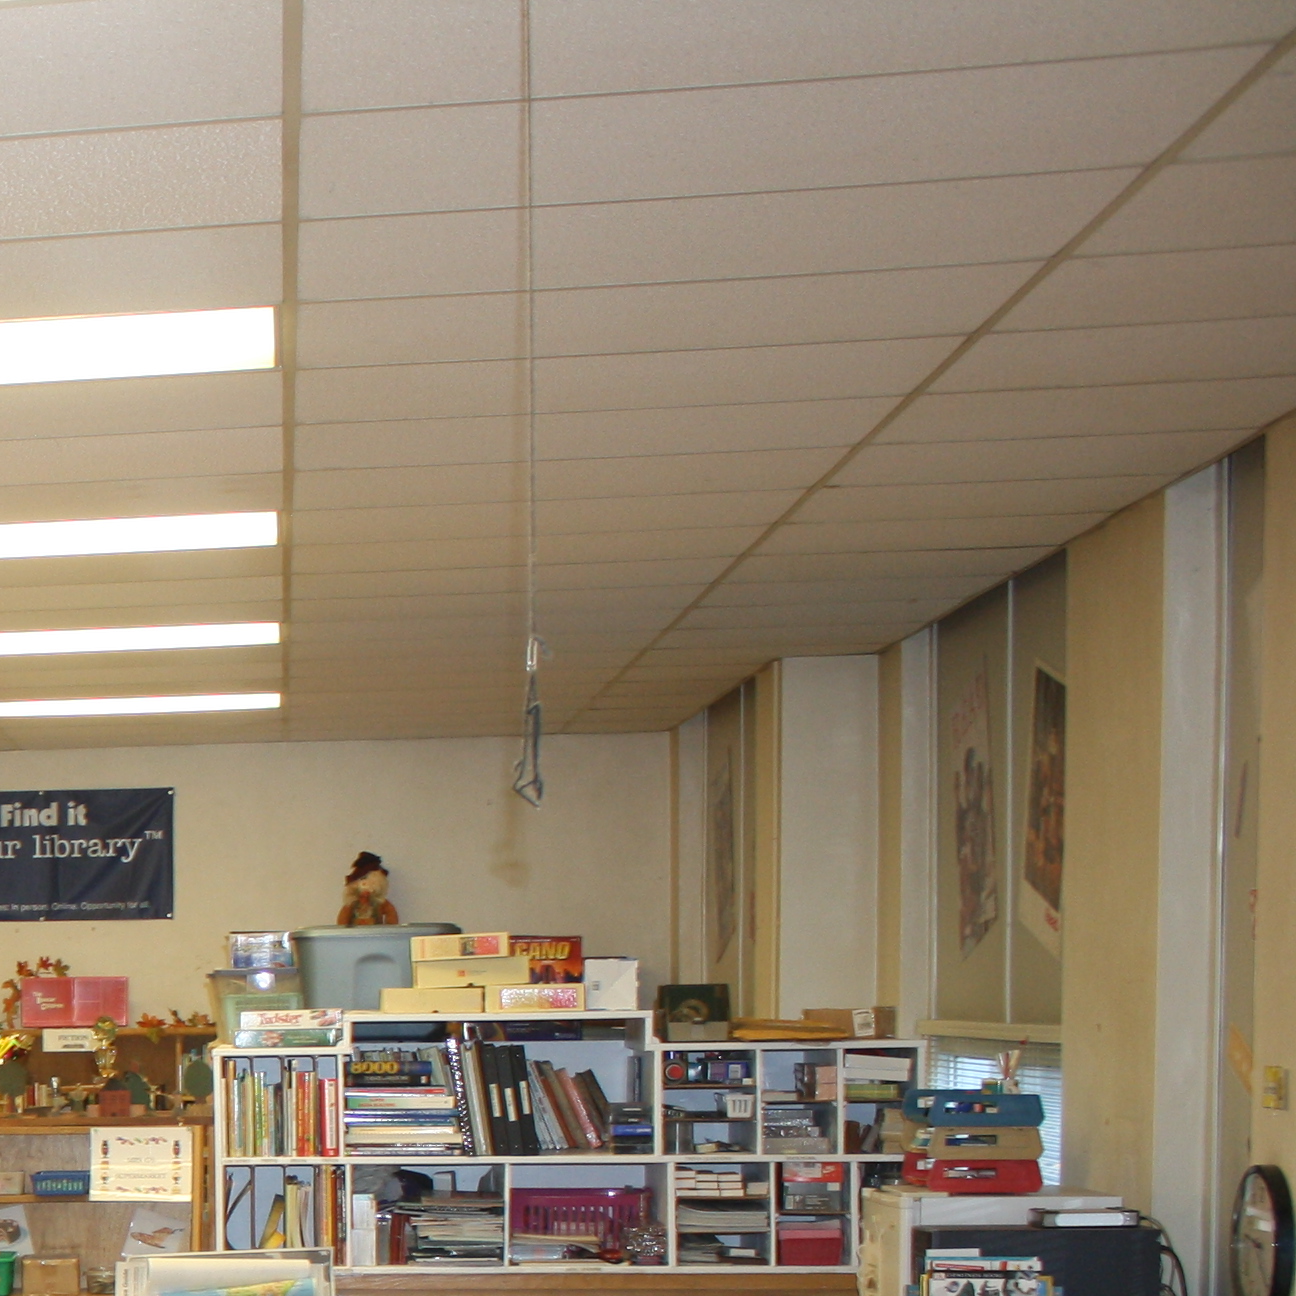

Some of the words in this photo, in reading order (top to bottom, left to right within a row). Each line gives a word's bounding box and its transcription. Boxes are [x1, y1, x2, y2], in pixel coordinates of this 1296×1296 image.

[0, 802, 57, 827] Find
[67, 801, 87, 826] it
[80, 900, 125, 911] Opportunity
[127, 900, 137, 909] for
[515, 941, 571, 960] CANO
